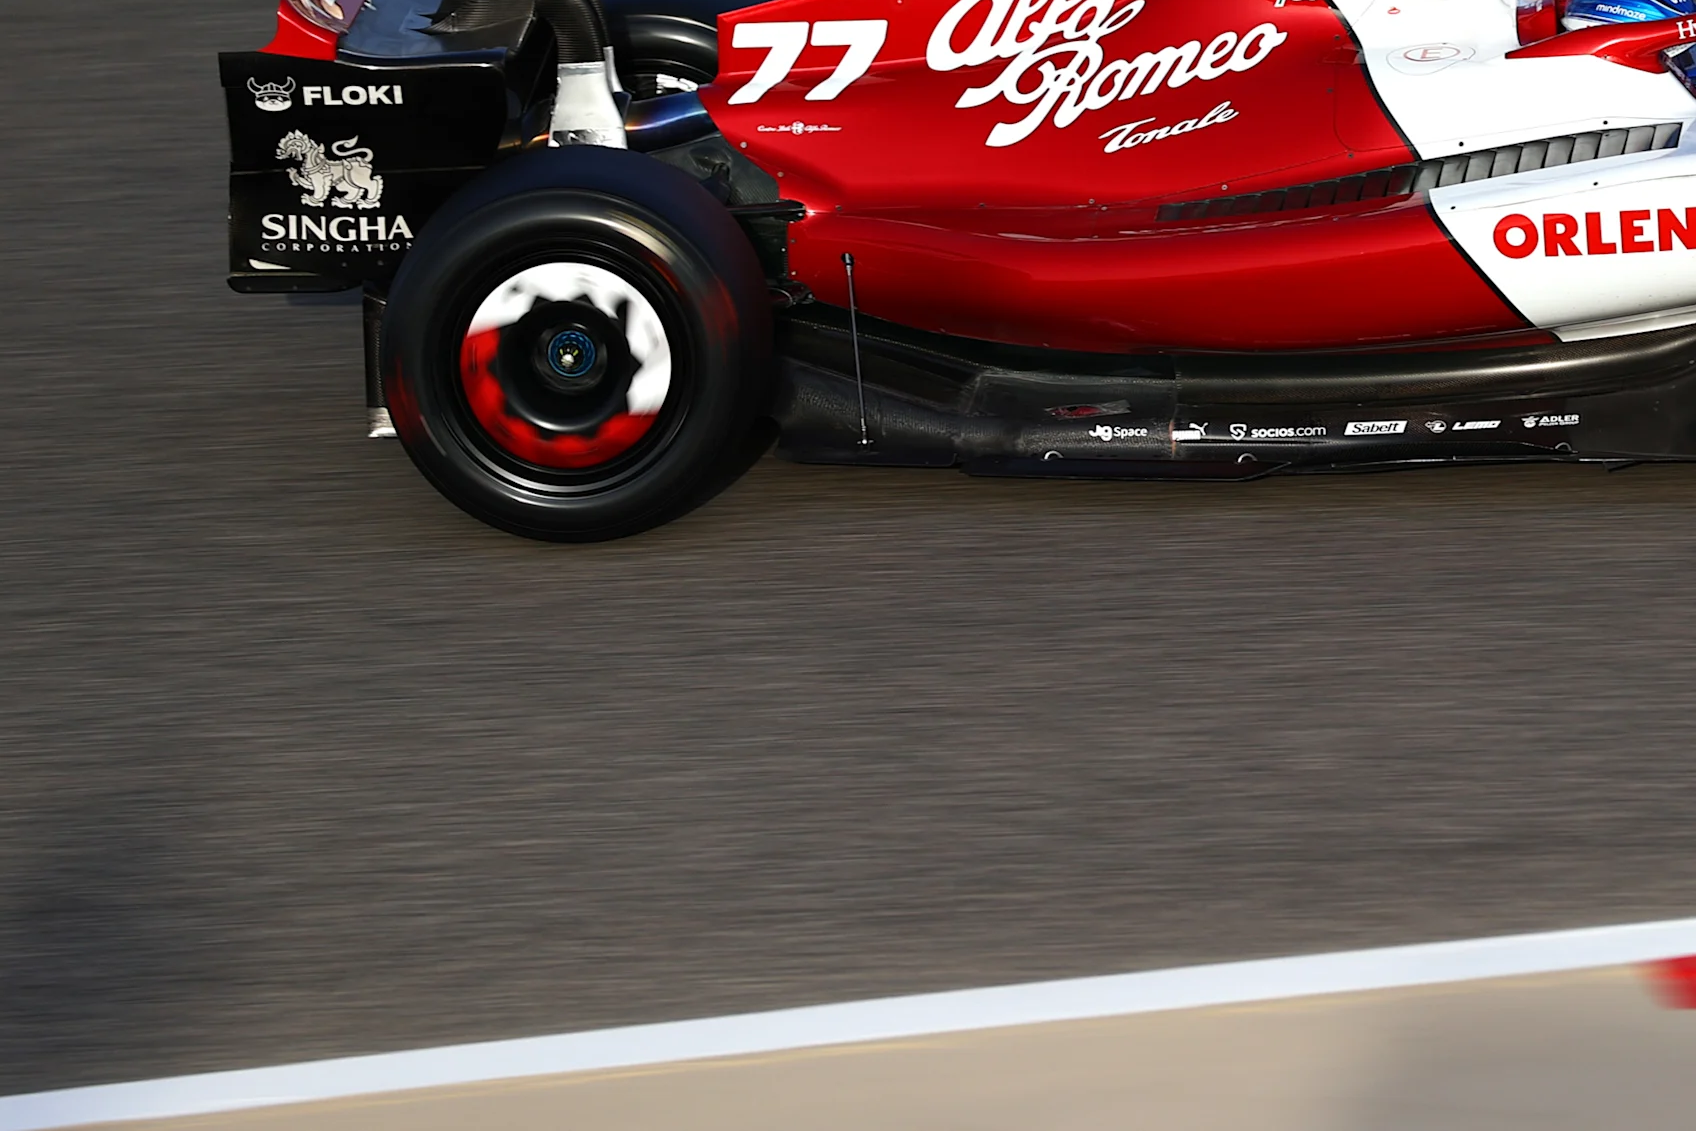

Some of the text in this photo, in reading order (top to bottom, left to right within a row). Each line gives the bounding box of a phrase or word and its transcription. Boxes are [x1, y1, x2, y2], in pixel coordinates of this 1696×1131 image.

[1596, 4, 1646, 20] mindmaze
[728, 19, 888, 105] 77
[955, 22, 1288, 147] Romeo
[302, 85, 404, 106] FLOKI
[1098, 100, 1240, 154] Tonale
[261, 213, 414, 242] SINGHA
[1352, 421, 1399, 434] Sabelt
[1452, 420, 1501, 431] LEMO
[1539, 414, 1580, 423] ADLER
[1251, 426, 1326, 439] socios.com
